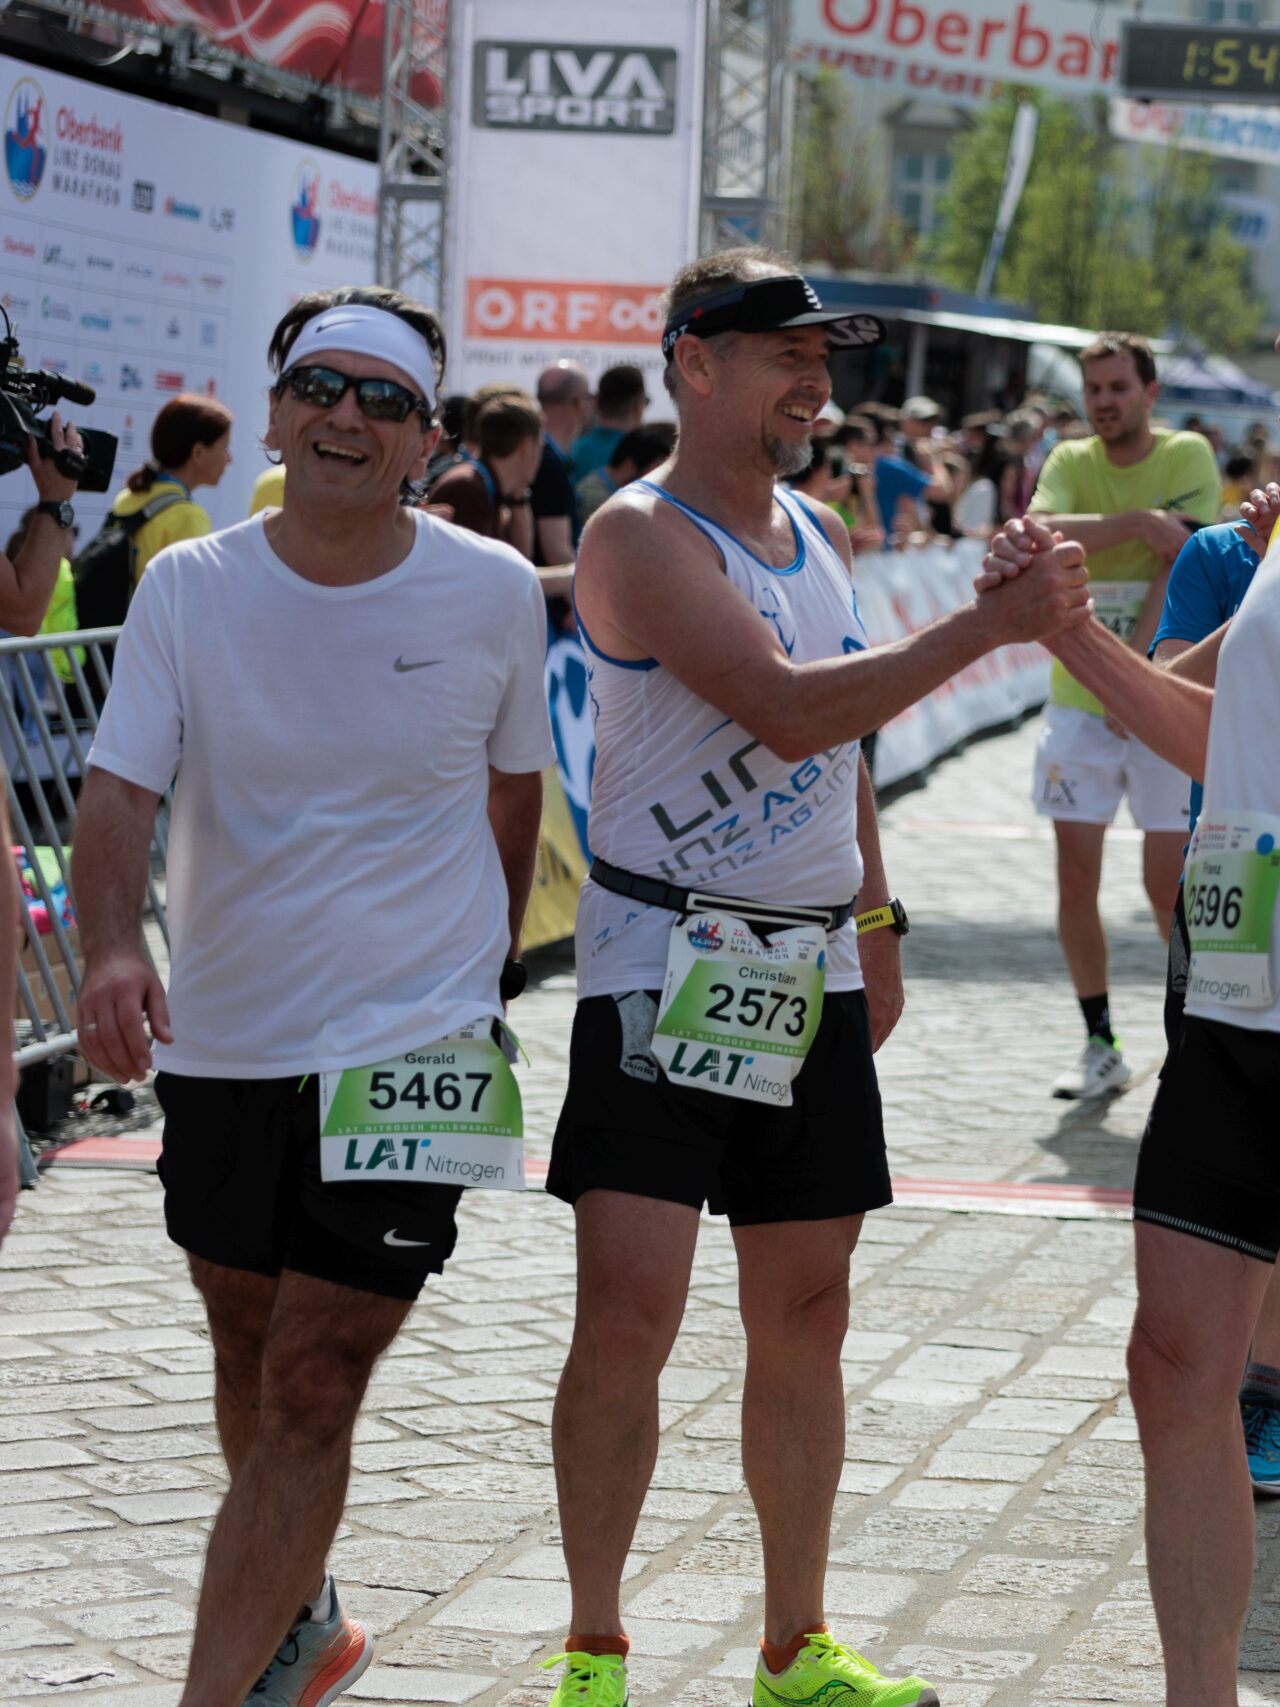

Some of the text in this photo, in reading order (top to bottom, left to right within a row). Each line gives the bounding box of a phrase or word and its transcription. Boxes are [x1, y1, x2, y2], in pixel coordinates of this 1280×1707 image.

[822, 0, 1118, 84] Oberba
[485, 46, 665, 98] LIVA
[56, 106, 124, 154] Oberbank
[484, 96, 665, 128] SPORT
[474, 288, 598, 333] ORF
[1188, 884, 1243, 930] 2596
[738, 966, 797, 986] Christian
[704, 983, 808, 1037] 2573
[404, 1052, 456, 1065] Gerald
[668, 1041, 746, 1086] LAT
[368, 1070, 493, 1113] 5467
[338, 1123, 513, 1135] LAT NITROGEN HALBMARATHON
[344, 1138, 506, 1182] LAT Nitrogen
